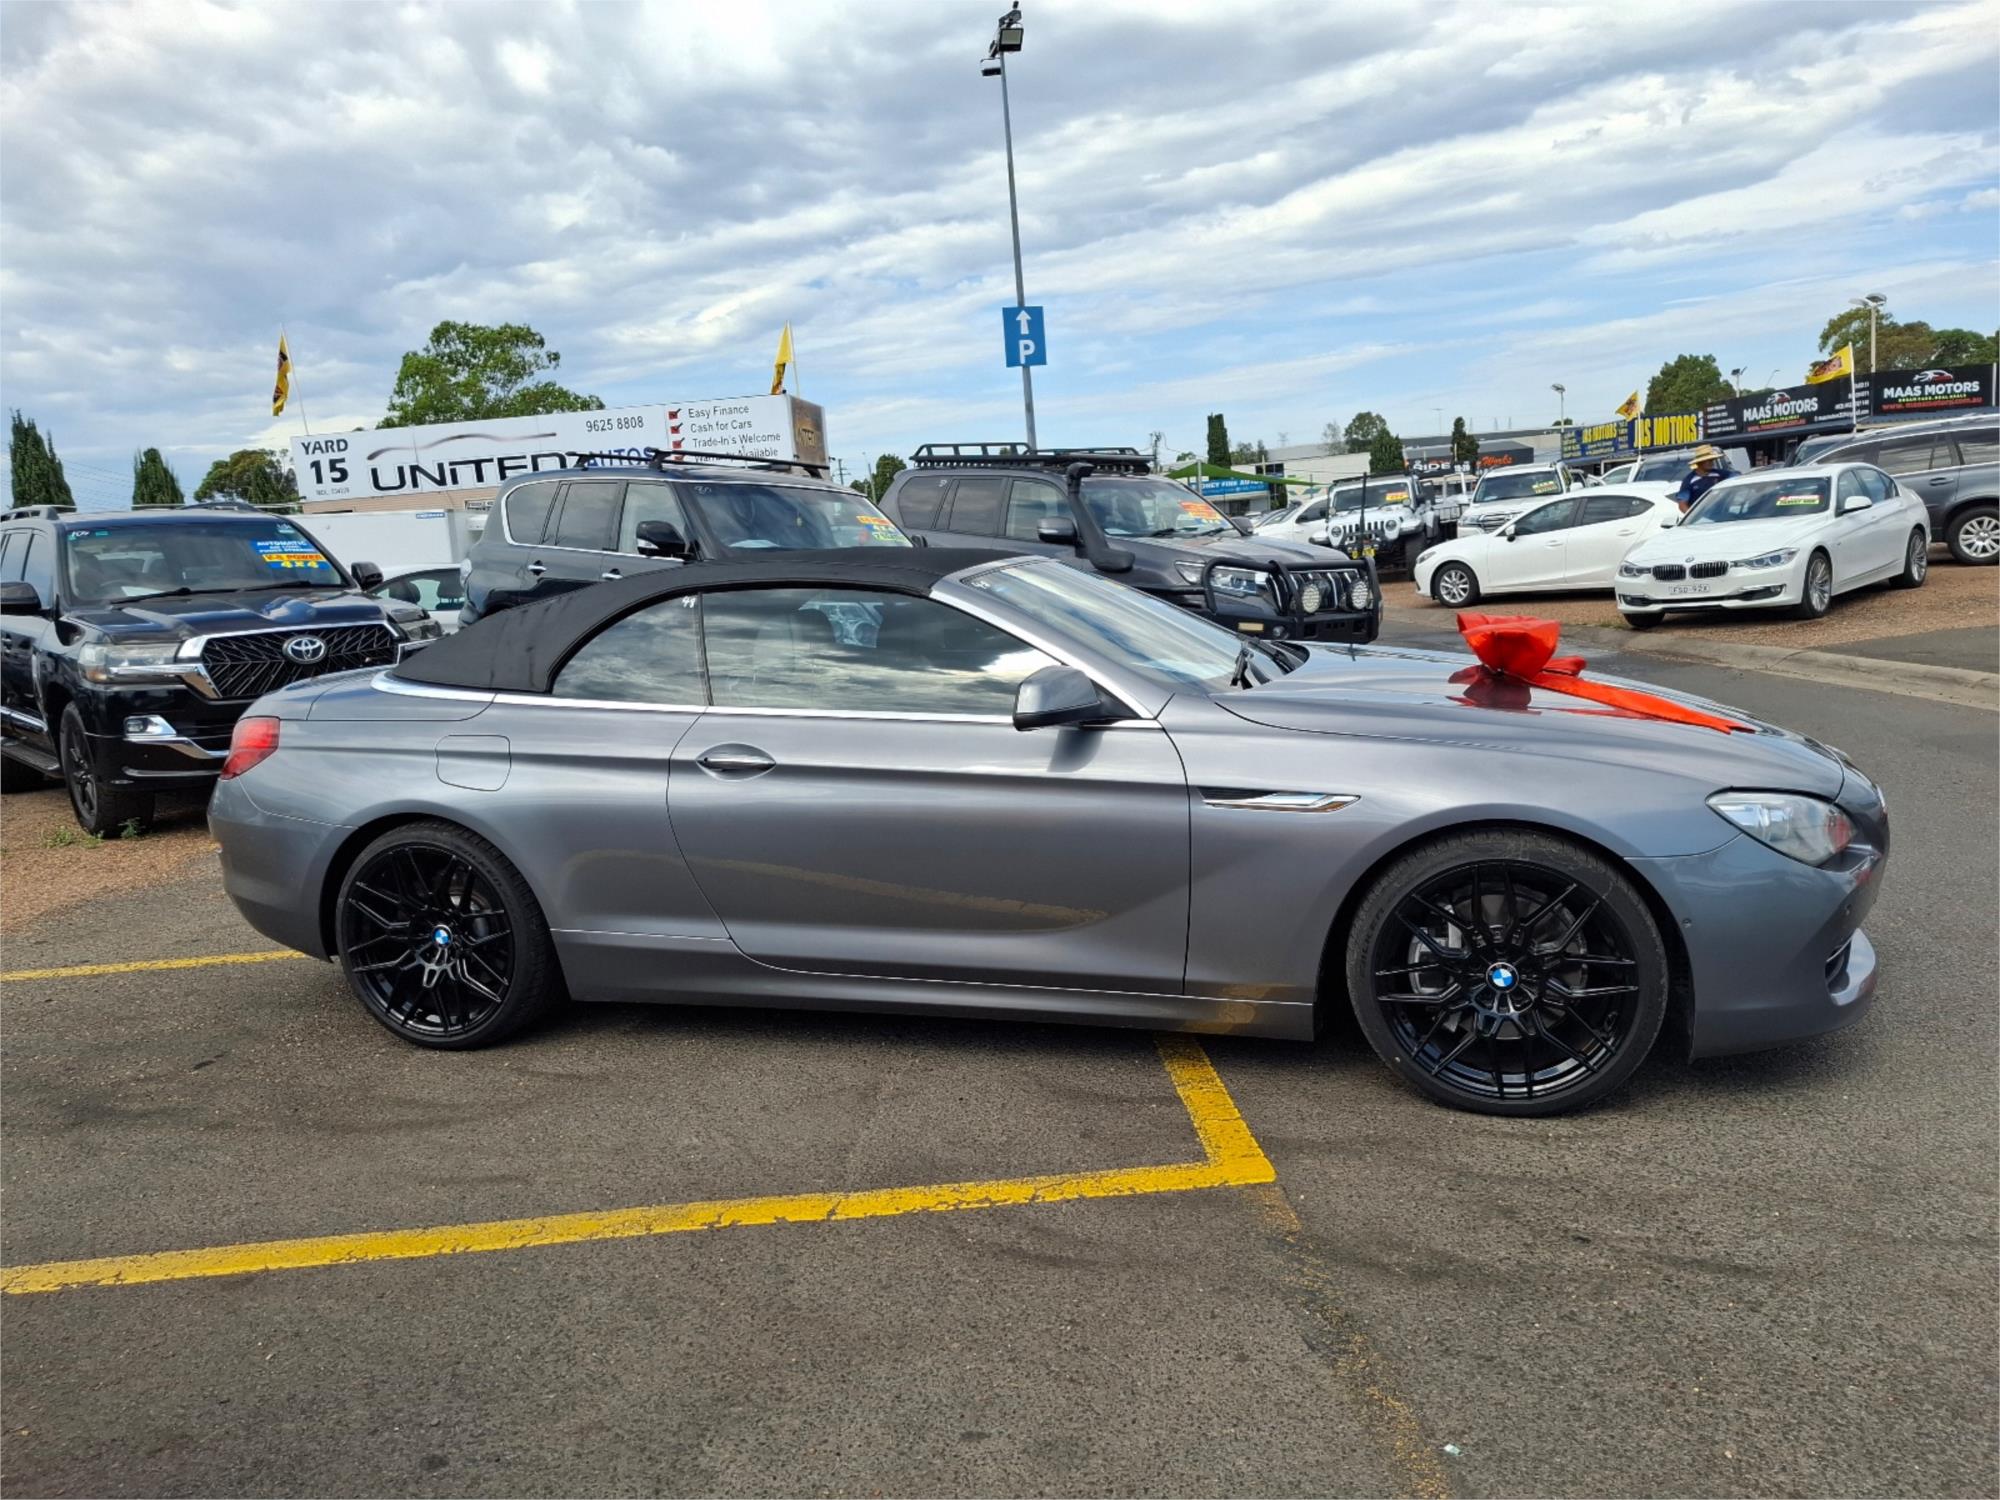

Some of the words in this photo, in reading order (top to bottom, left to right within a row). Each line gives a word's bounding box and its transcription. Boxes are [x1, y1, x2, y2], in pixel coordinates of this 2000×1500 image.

[1018, 339, 1035, 364] P
[1883, 385, 1922, 399] MAAS
[1924, 381, 1980, 395] MOTORS
[687, 407, 711, 420] Easy
[713, 404, 750, 416] Finance
[1743, 403, 1772, 422] MAAS
[1773, 397, 1819, 418] MOTORS
[585, 417, 614, 432] 9625
[616, 415, 645, 430] 8808
[690, 422, 714, 434] Cash
[715, 421, 729, 432] for
[730, 419, 753, 430] Cars
[1653, 413, 1697, 446] MOTORS
[301, 438, 349, 455] YARD
[739, 432, 782, 445] Welcome
[310, 457, 349, 485] 15
